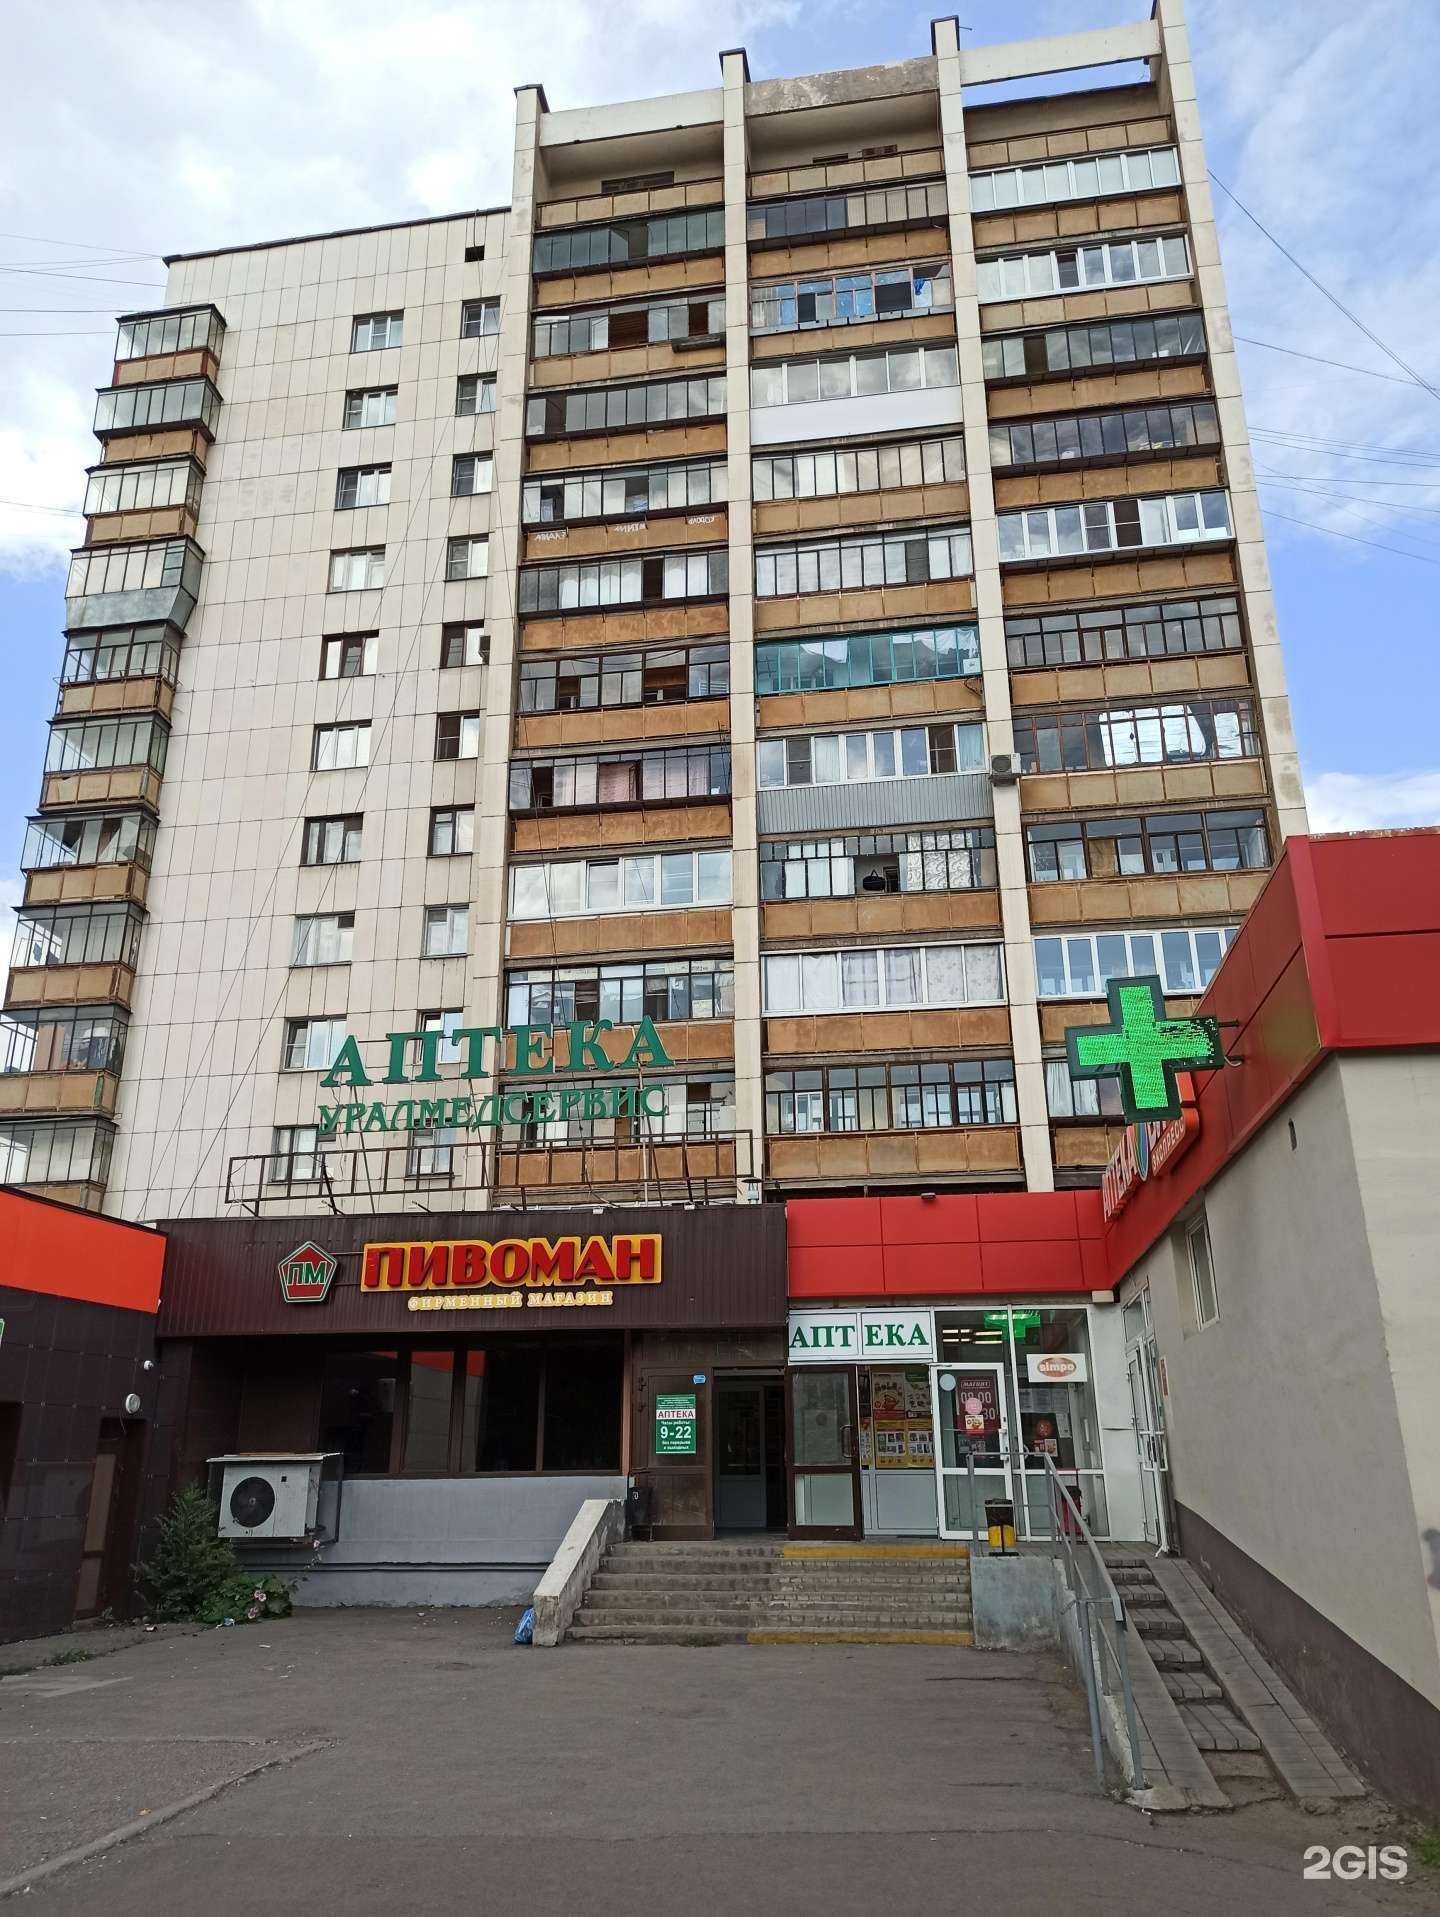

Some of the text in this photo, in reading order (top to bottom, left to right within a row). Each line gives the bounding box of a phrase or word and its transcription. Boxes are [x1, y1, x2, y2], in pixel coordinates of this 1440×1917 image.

[320, 1015, 675, 1087] АПТЕКА
[318, 1084, 671, 1135] УРАЛМЕДСЕРВИС
[286, 1261, 328, 1285] ПМ
[363, 1238, 656, 1288] ПИВОМАН
[408, 1291, 614, 1311] ФИРМЕННЫЙ МАГАЗИН
[658, 1410, 694, 1419] АПТЕКА
